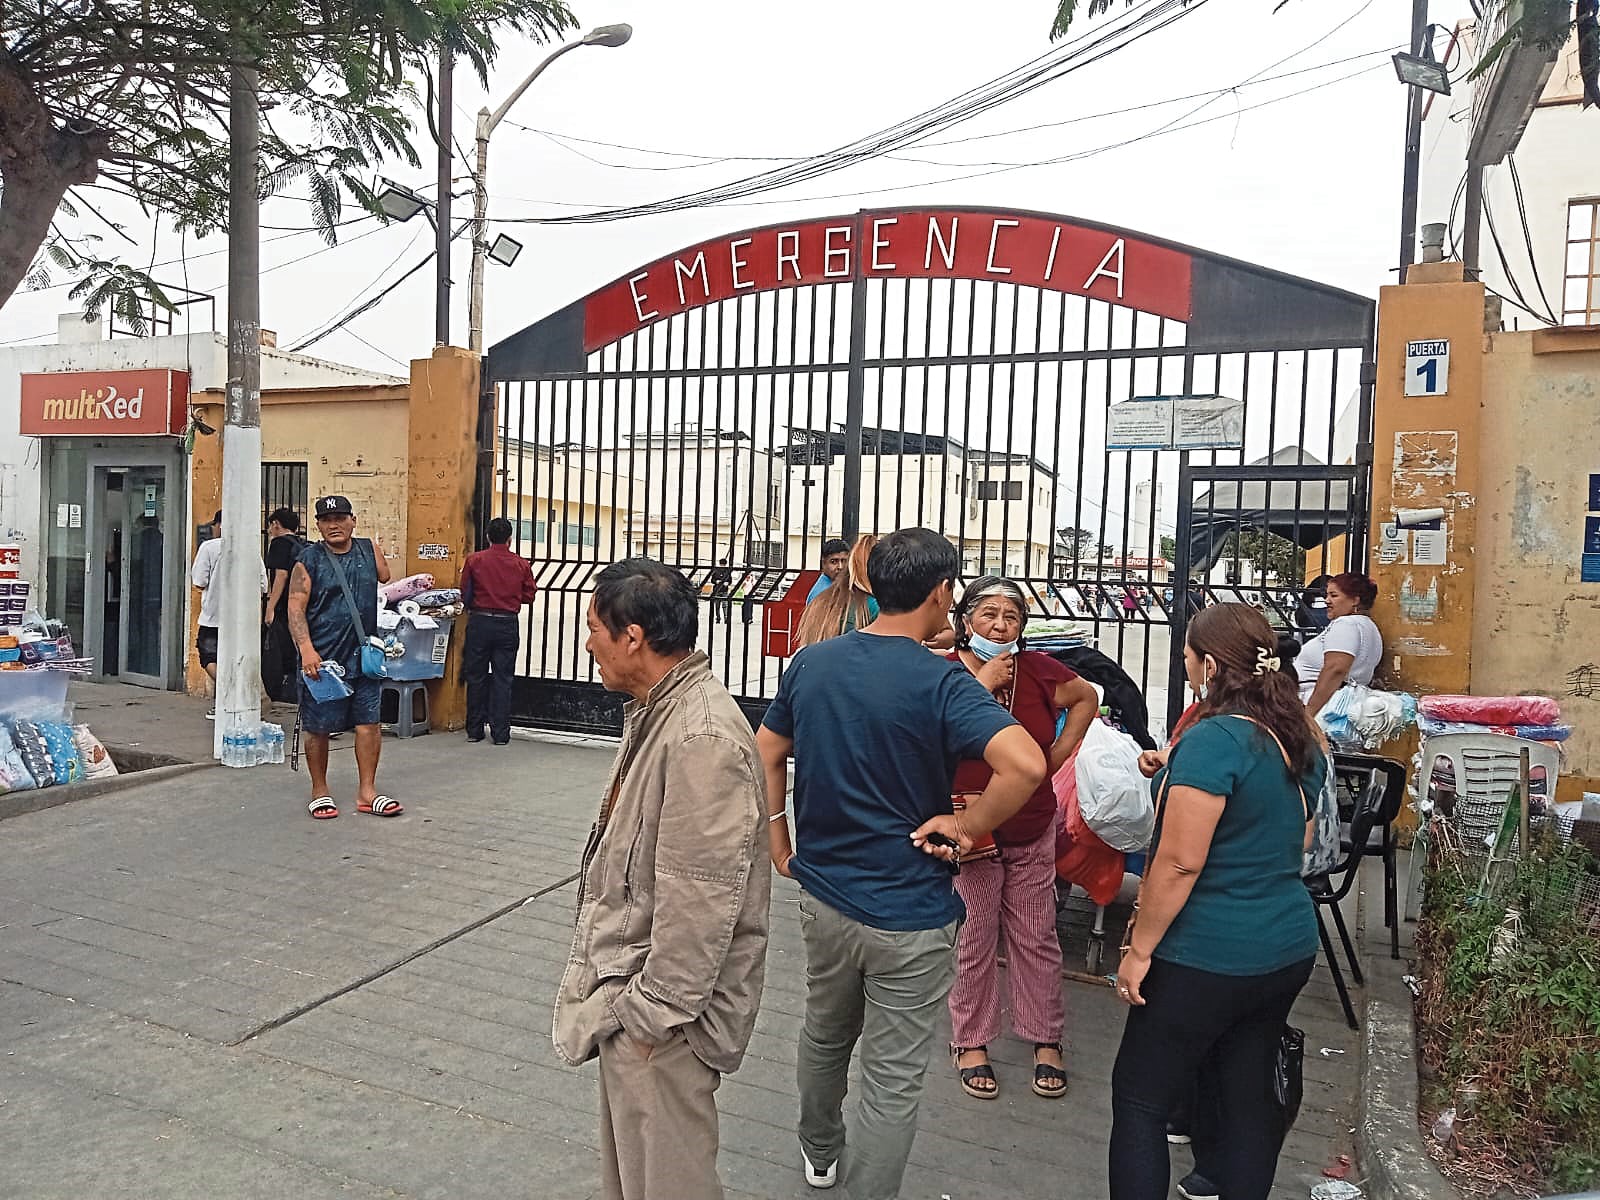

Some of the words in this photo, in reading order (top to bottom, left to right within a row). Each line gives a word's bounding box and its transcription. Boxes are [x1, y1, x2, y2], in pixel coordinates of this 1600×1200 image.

[629, 216, 1126, 321] EMERGENCIA
[1409, 342, 1446, 356] PUERTA
[1416, 358, 1437, 393] 1
[42, 386, 144, 420] multiRed
[325, 498, 337, 509] NY
[766, 607, 792, 655] H
